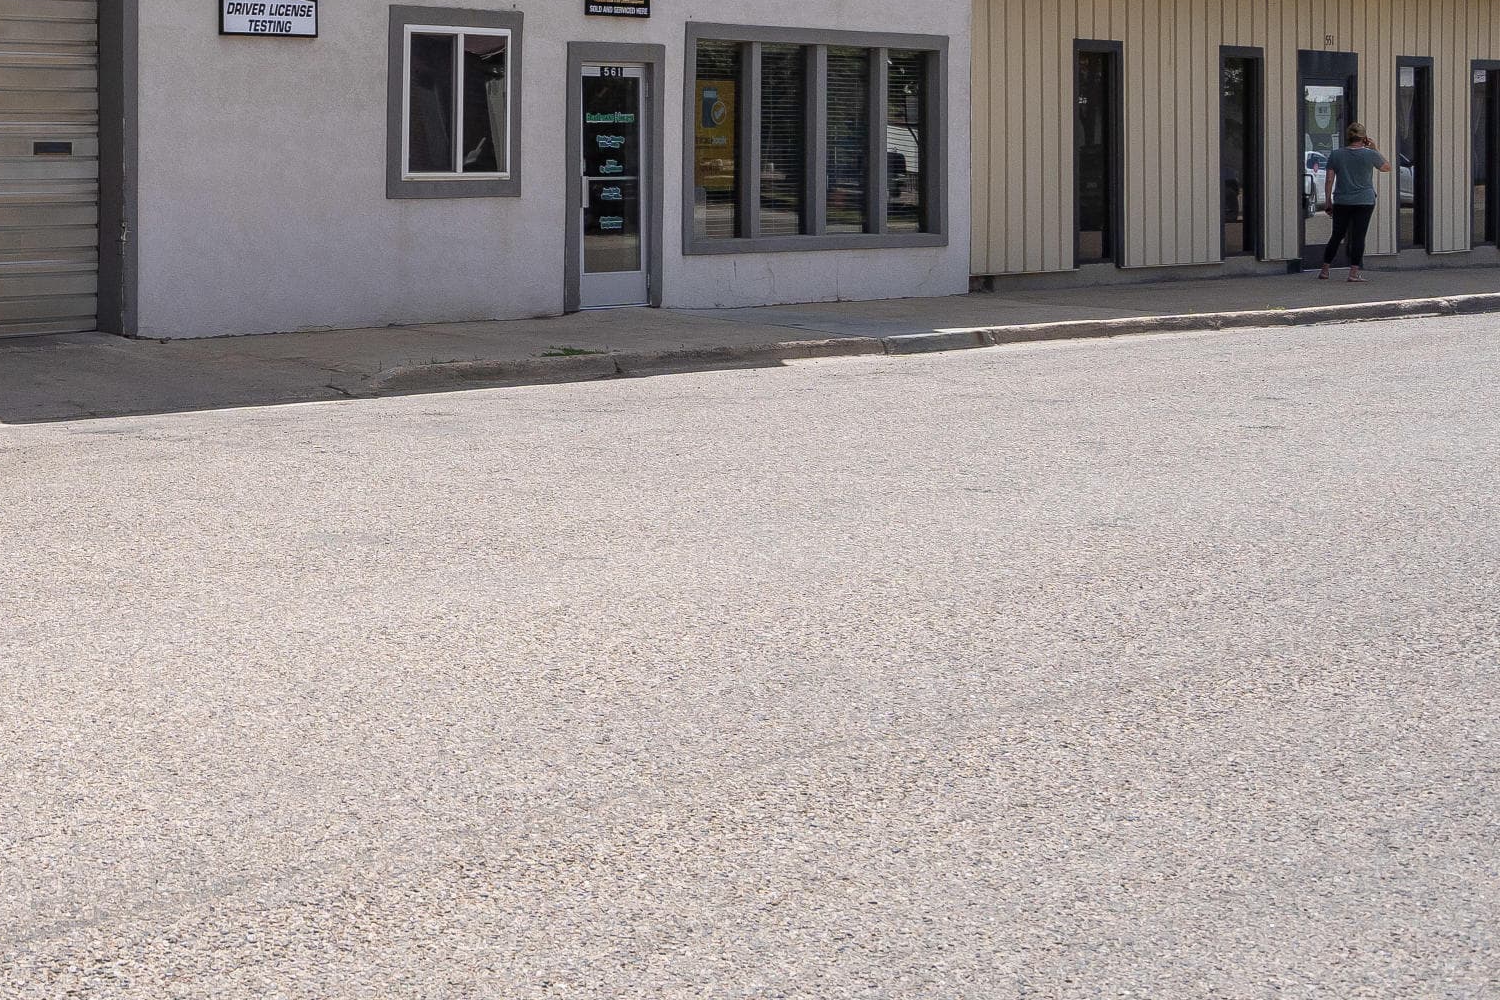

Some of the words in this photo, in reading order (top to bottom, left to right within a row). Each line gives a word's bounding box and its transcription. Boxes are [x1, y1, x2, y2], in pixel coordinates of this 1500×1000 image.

[227, 2, 265, 16] DRIVER
[269, 4, 313, 18] LICENSE
[249, 19, 292, 33] TESTING
[604, 68, 621, 77] 561
